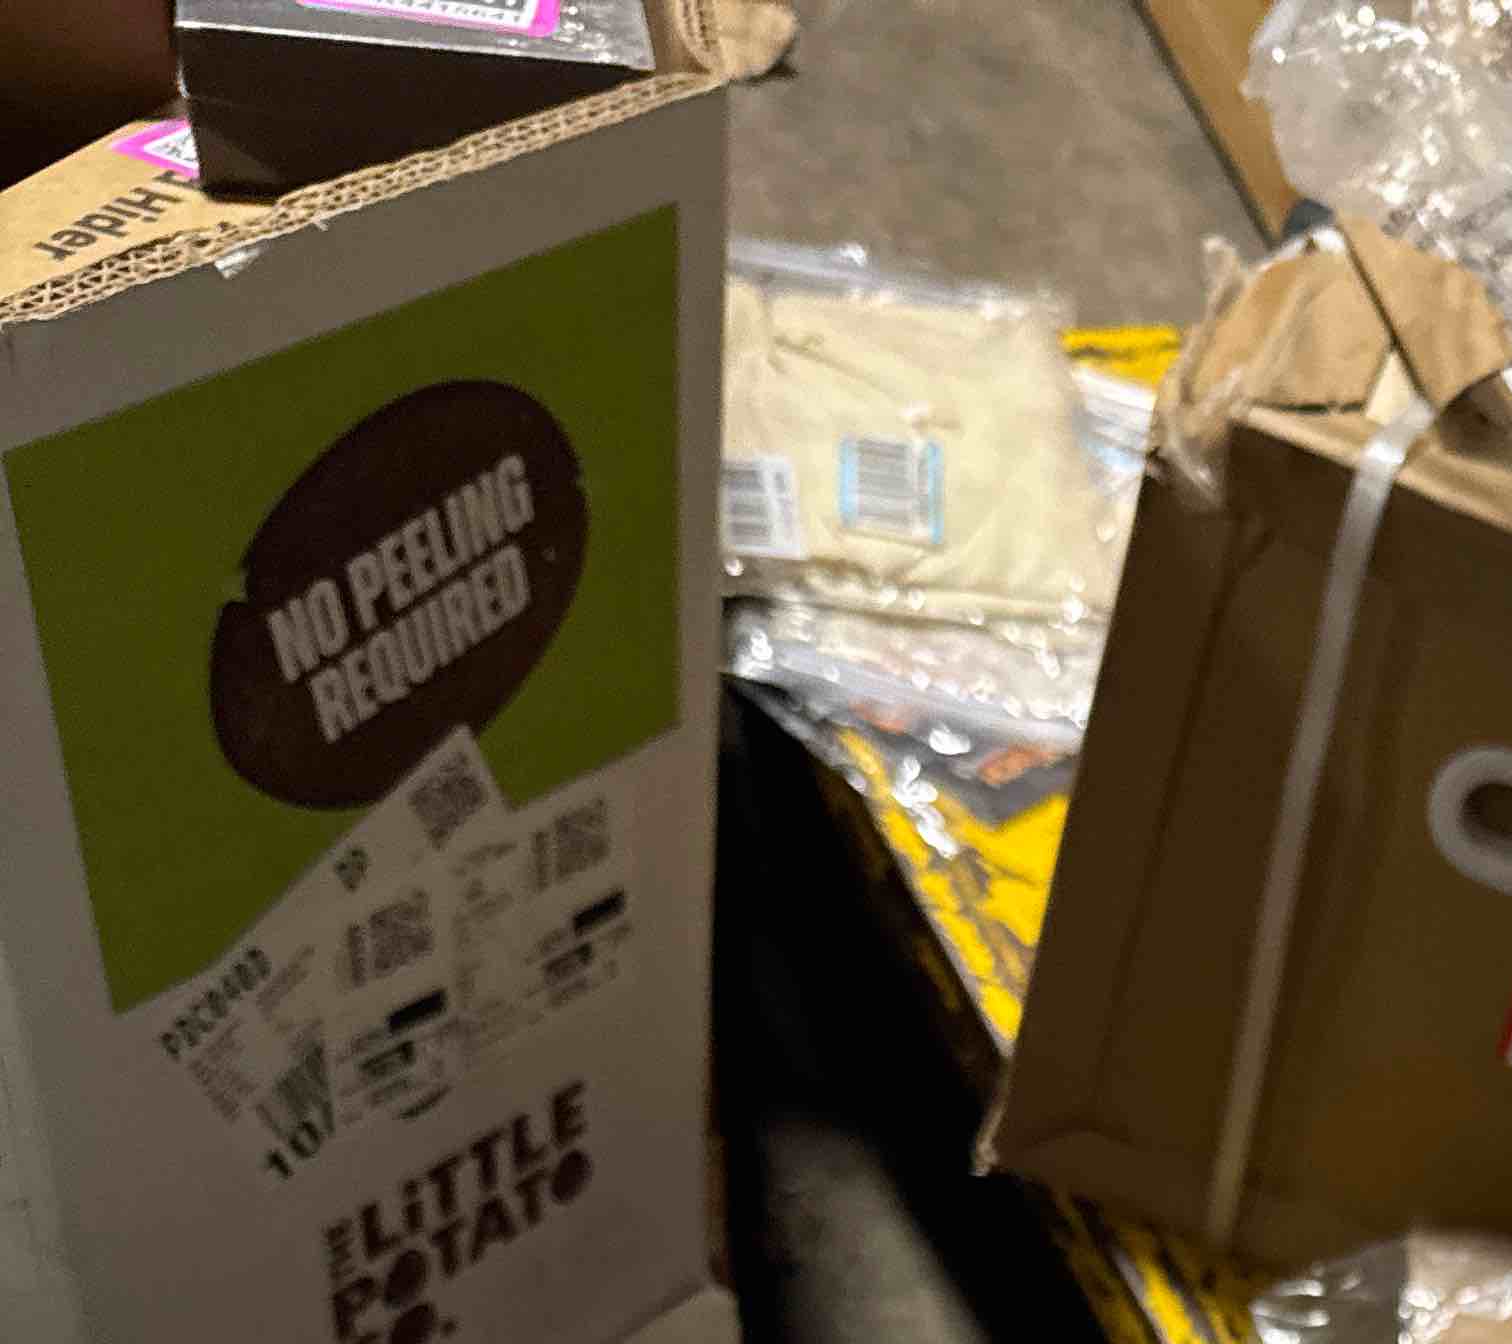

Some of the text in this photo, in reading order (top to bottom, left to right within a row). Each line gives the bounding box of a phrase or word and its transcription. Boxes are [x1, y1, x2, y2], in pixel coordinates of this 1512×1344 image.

[32, 187, 184, 262] Hider
[266, 454, 536, 683] NO PEELING
[307, 542, 534, 745] REQUIRED
[330, 1148, 594, 1343] POTATO
